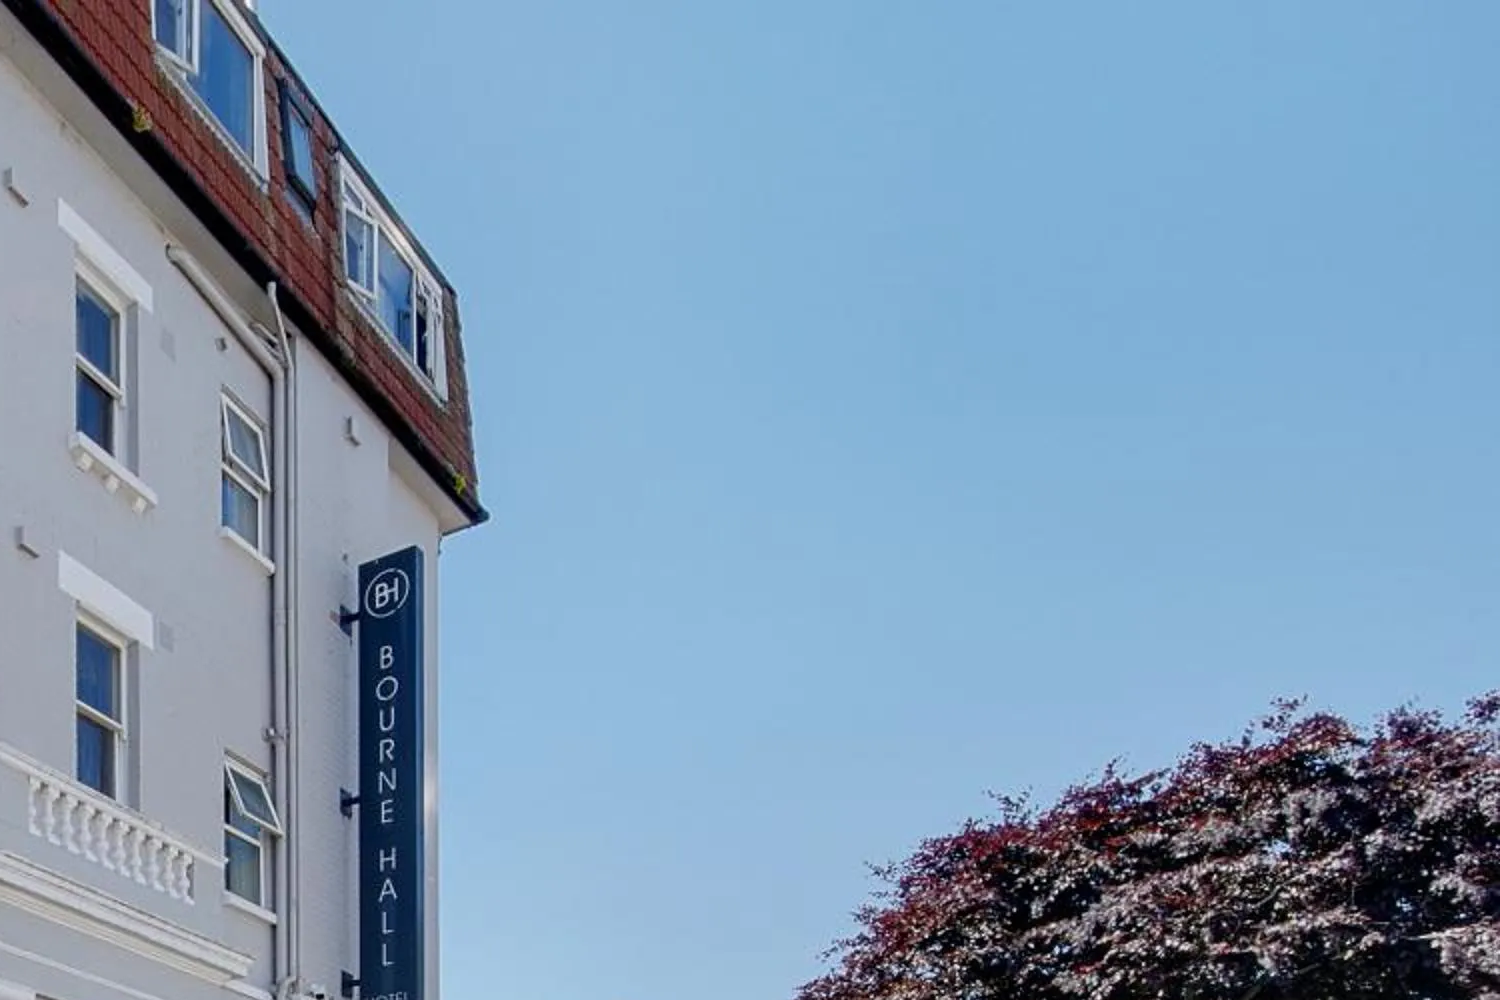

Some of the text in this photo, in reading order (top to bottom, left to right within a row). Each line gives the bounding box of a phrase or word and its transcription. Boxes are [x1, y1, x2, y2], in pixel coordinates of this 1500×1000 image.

[374, 577, 399, 609] BH
[375, 645, 399, 967] BOURNE HALL
